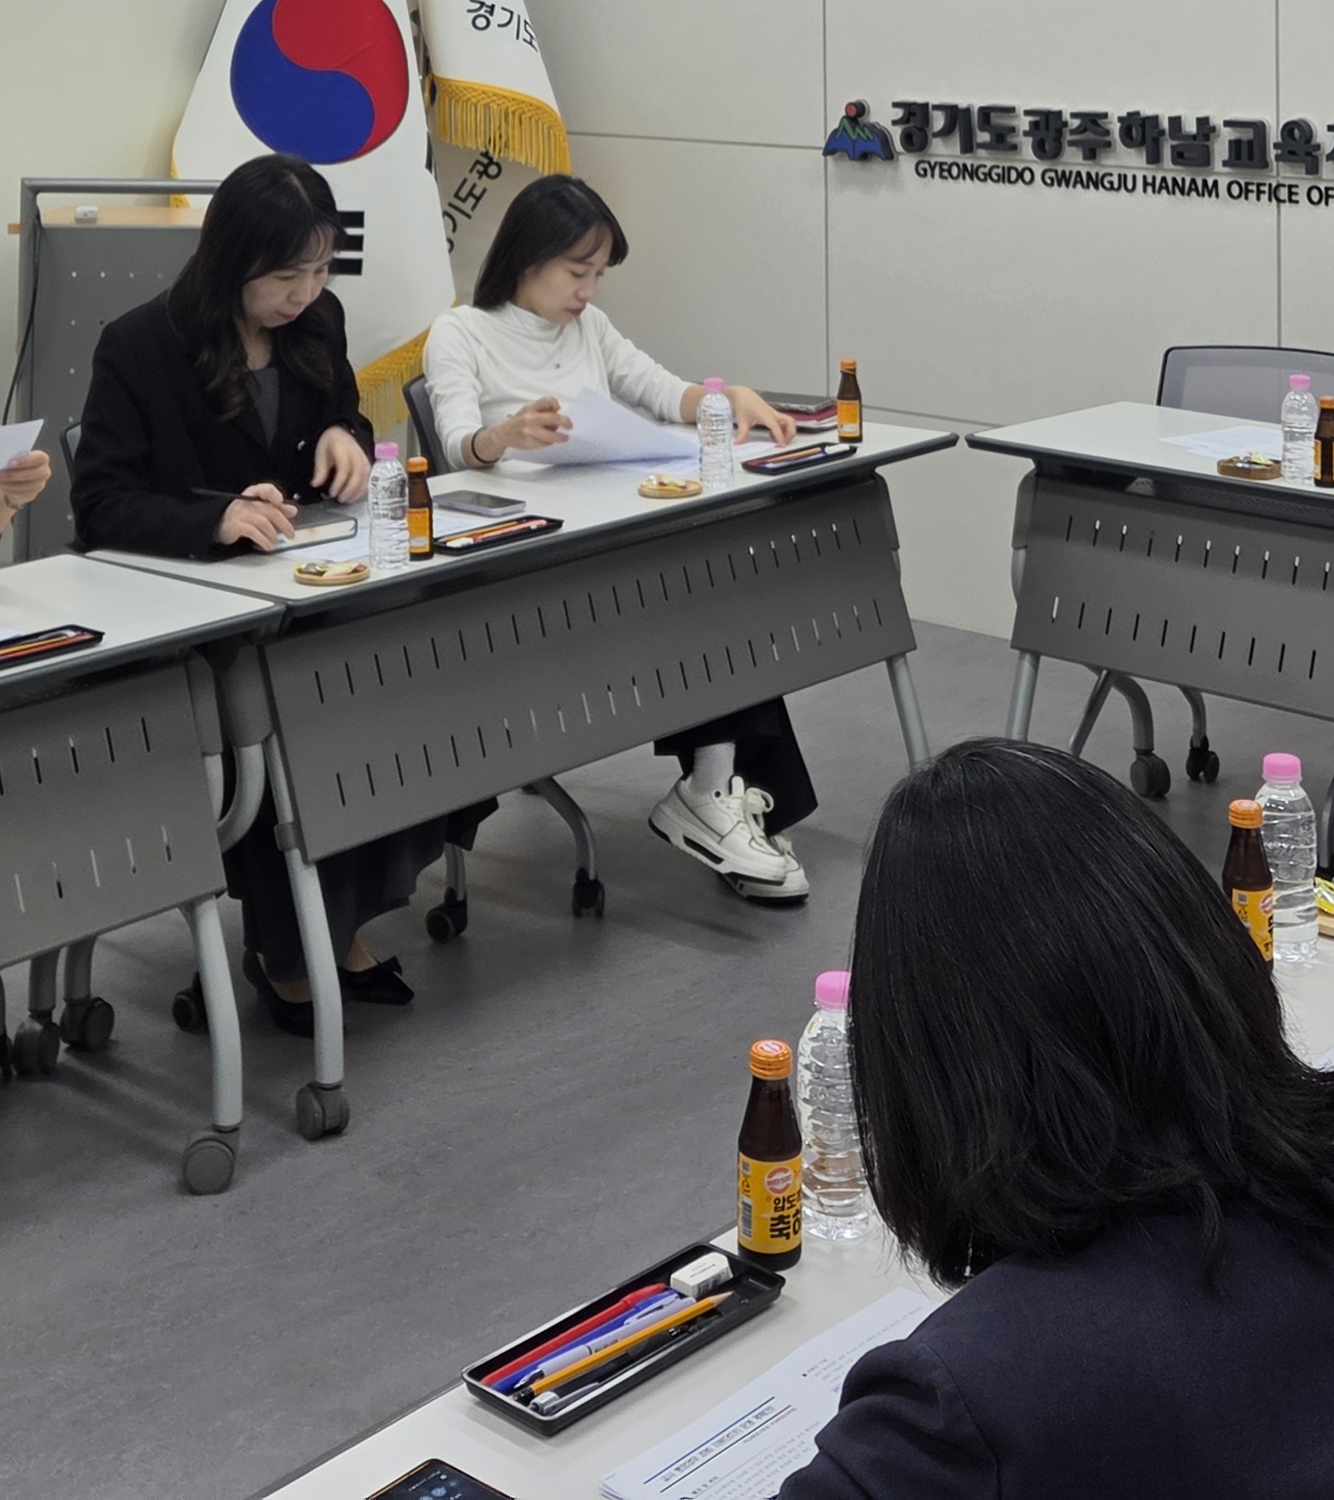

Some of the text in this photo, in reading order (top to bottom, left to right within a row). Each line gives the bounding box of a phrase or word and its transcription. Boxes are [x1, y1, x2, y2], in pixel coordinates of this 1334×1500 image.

[914, 159, 1035, 186] GYEONGGIDO
[1040, 167, 1137, 194] GWANGJU
[1141, 174, 1220, 200] HANAM
[1226, 179, 1300, 205] OFFICE
